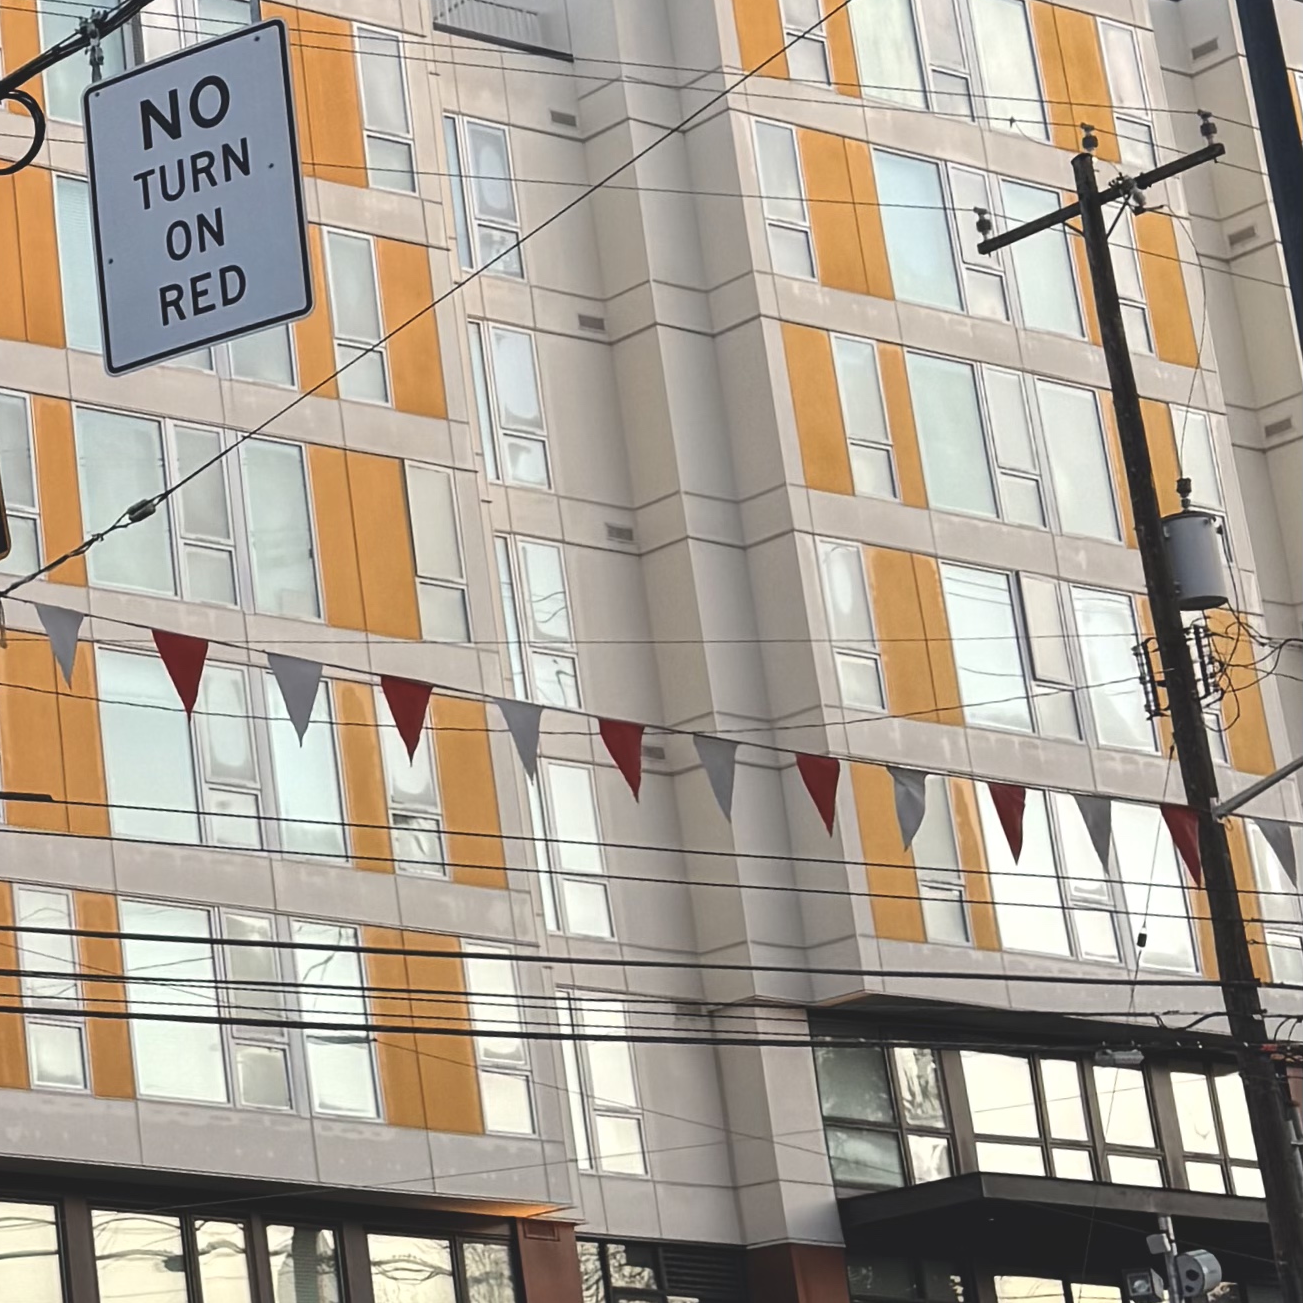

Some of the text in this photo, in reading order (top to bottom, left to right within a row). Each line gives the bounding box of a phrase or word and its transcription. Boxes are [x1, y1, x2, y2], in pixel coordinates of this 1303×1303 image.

[140, 75, 230, 151] NO
[133, 137, 251, 210] TURN
[166, 207, 225, 261] ON
[159, 264, 246, 326] RED
